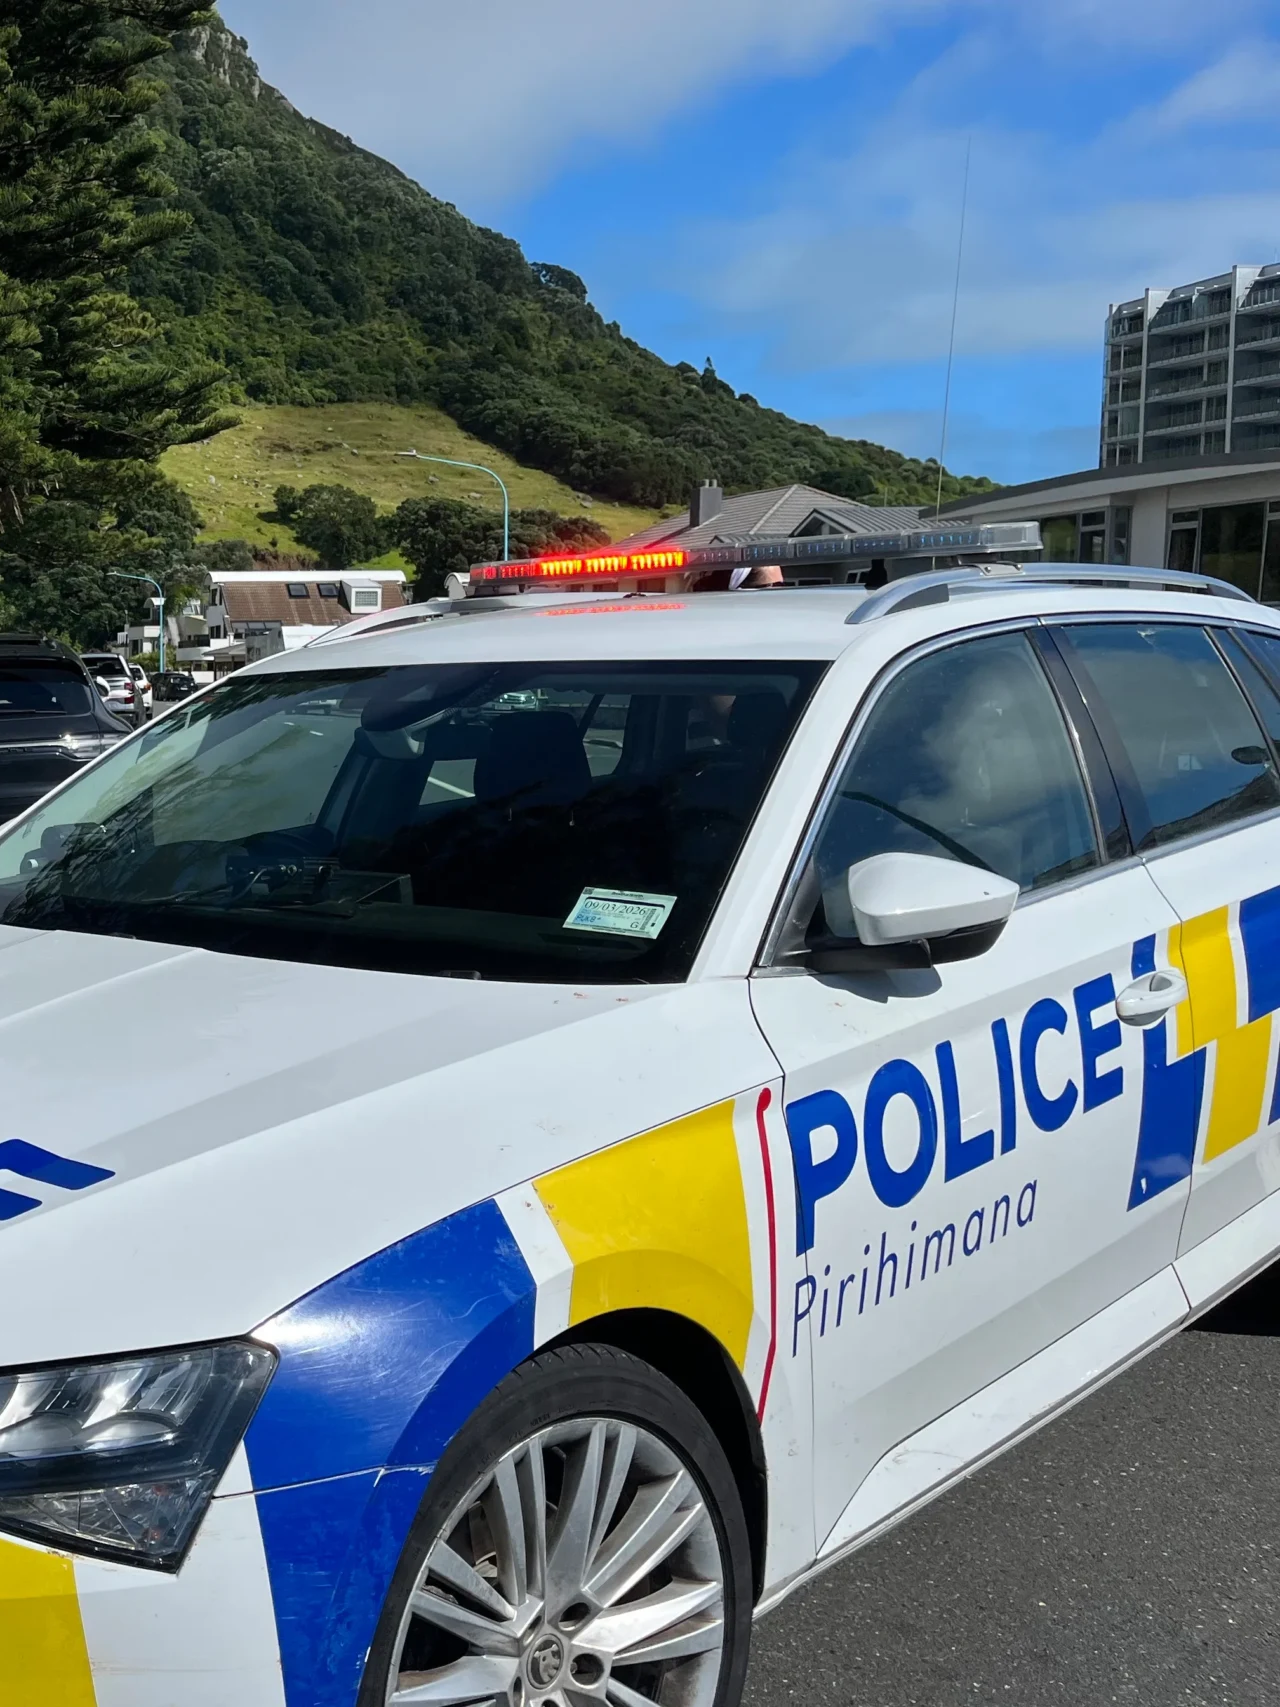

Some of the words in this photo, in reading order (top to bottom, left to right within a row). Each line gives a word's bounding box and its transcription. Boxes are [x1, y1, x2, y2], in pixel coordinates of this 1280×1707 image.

[584, 900, 646, 916] 09/03/2026
[630, 921, 640, 929] G
[785, 972, 1123, 1257] POLICE
[791, 1178, 1038, 1358] Pirihimana
